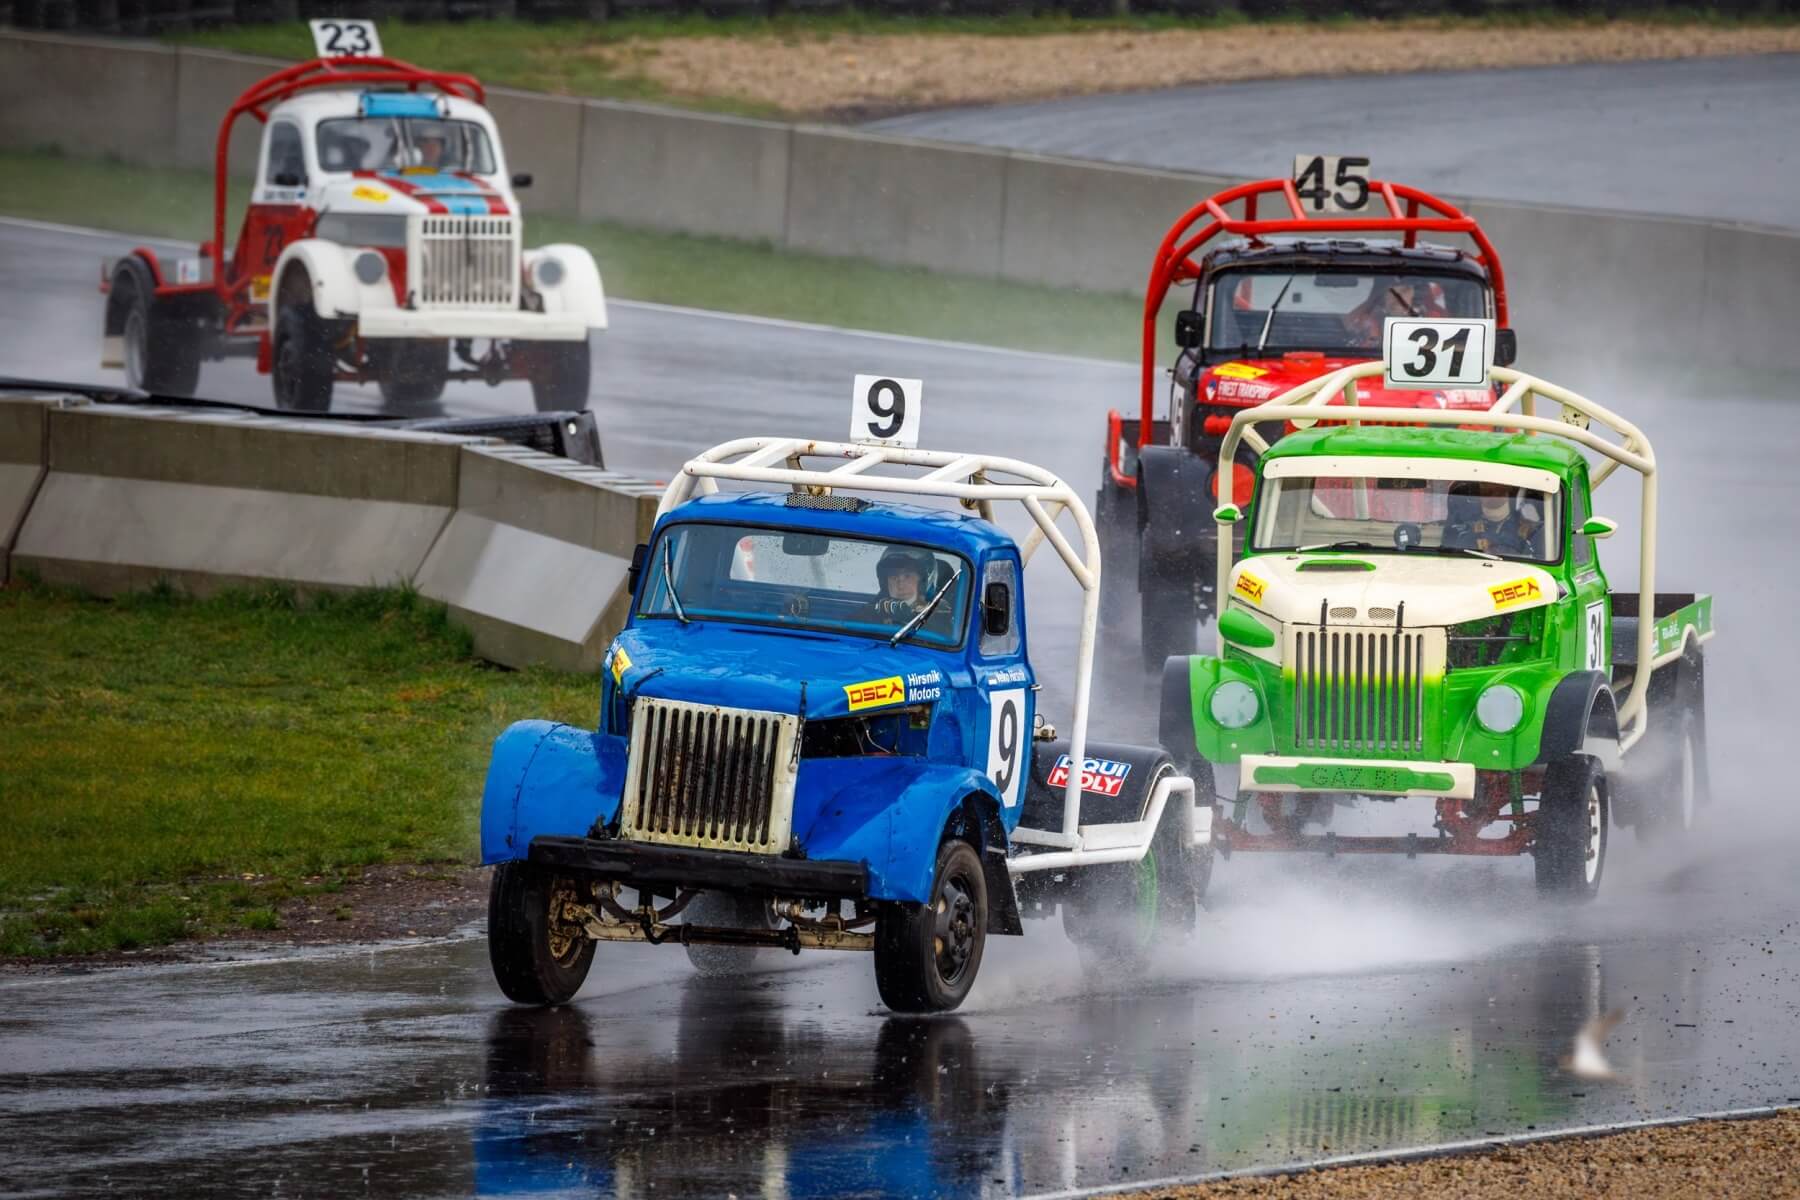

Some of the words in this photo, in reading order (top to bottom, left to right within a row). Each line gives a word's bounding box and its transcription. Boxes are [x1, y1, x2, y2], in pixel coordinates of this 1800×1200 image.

[320, 23, 371, 52] 23
[1296, 156, 1370, 210] 45
[1403, 327, 1471, 378] 31
[867, 379, 906, 439] 9
[1590, 611, 1602, 669] 31
[907, 669, 941, 687] Hirsnik
[908, 686, 941, 703] Motors
[995, 699, 1018, 794] 9
[1059, 756, 1127, 777] LQUI
[1311, 767, 1366, 788] GAZ
[1374, 769, 1399, 789] 51
